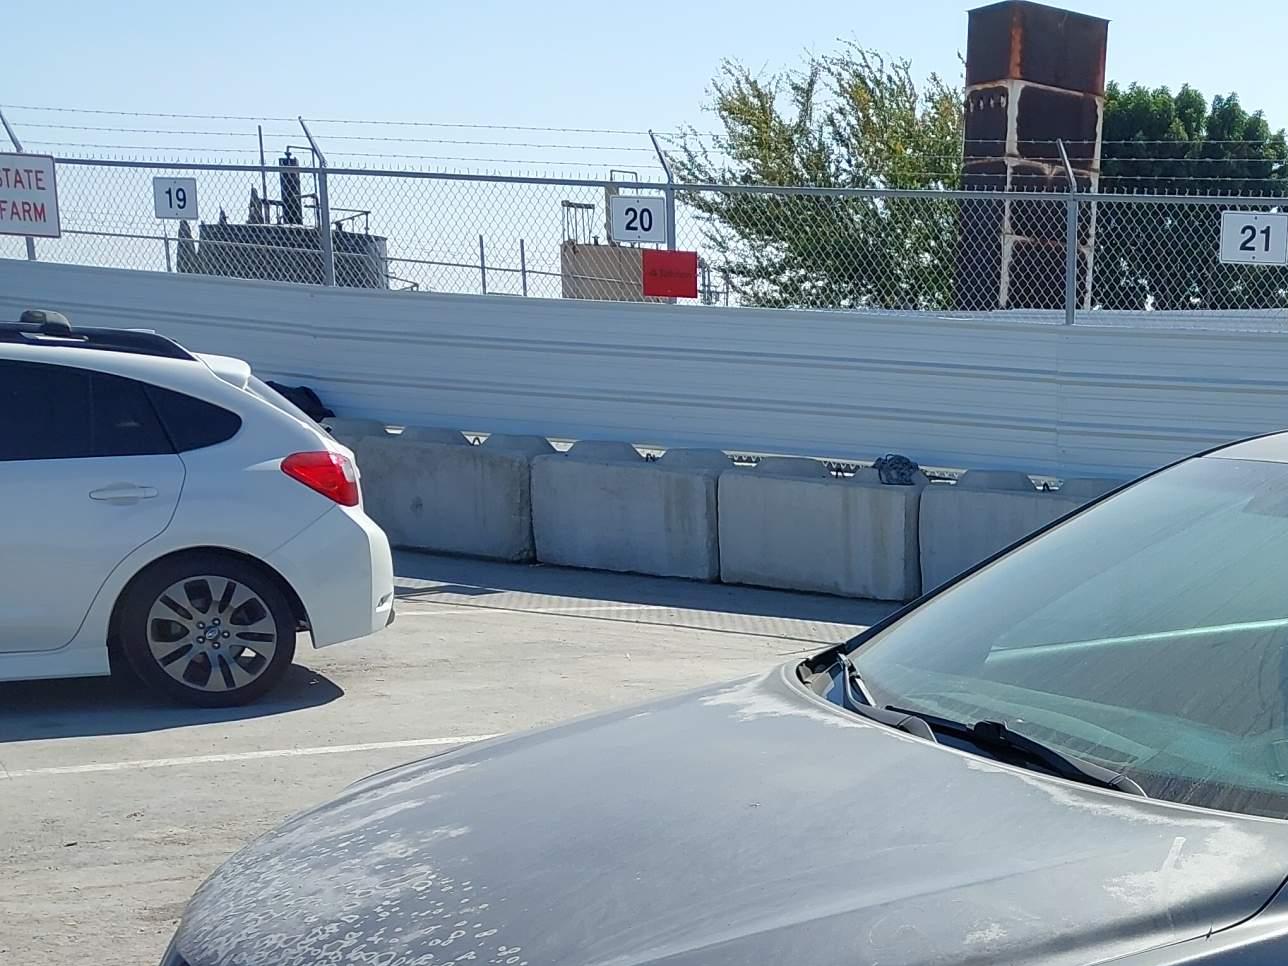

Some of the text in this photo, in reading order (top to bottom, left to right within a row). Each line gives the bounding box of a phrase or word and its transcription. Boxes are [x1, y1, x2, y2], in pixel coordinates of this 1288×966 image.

[165, 187, 187, 209] 19
[0, 200, 46, 222] FARM
[624, 207, 653, 231] 20
[1239, 224, 1272, 252] 21
